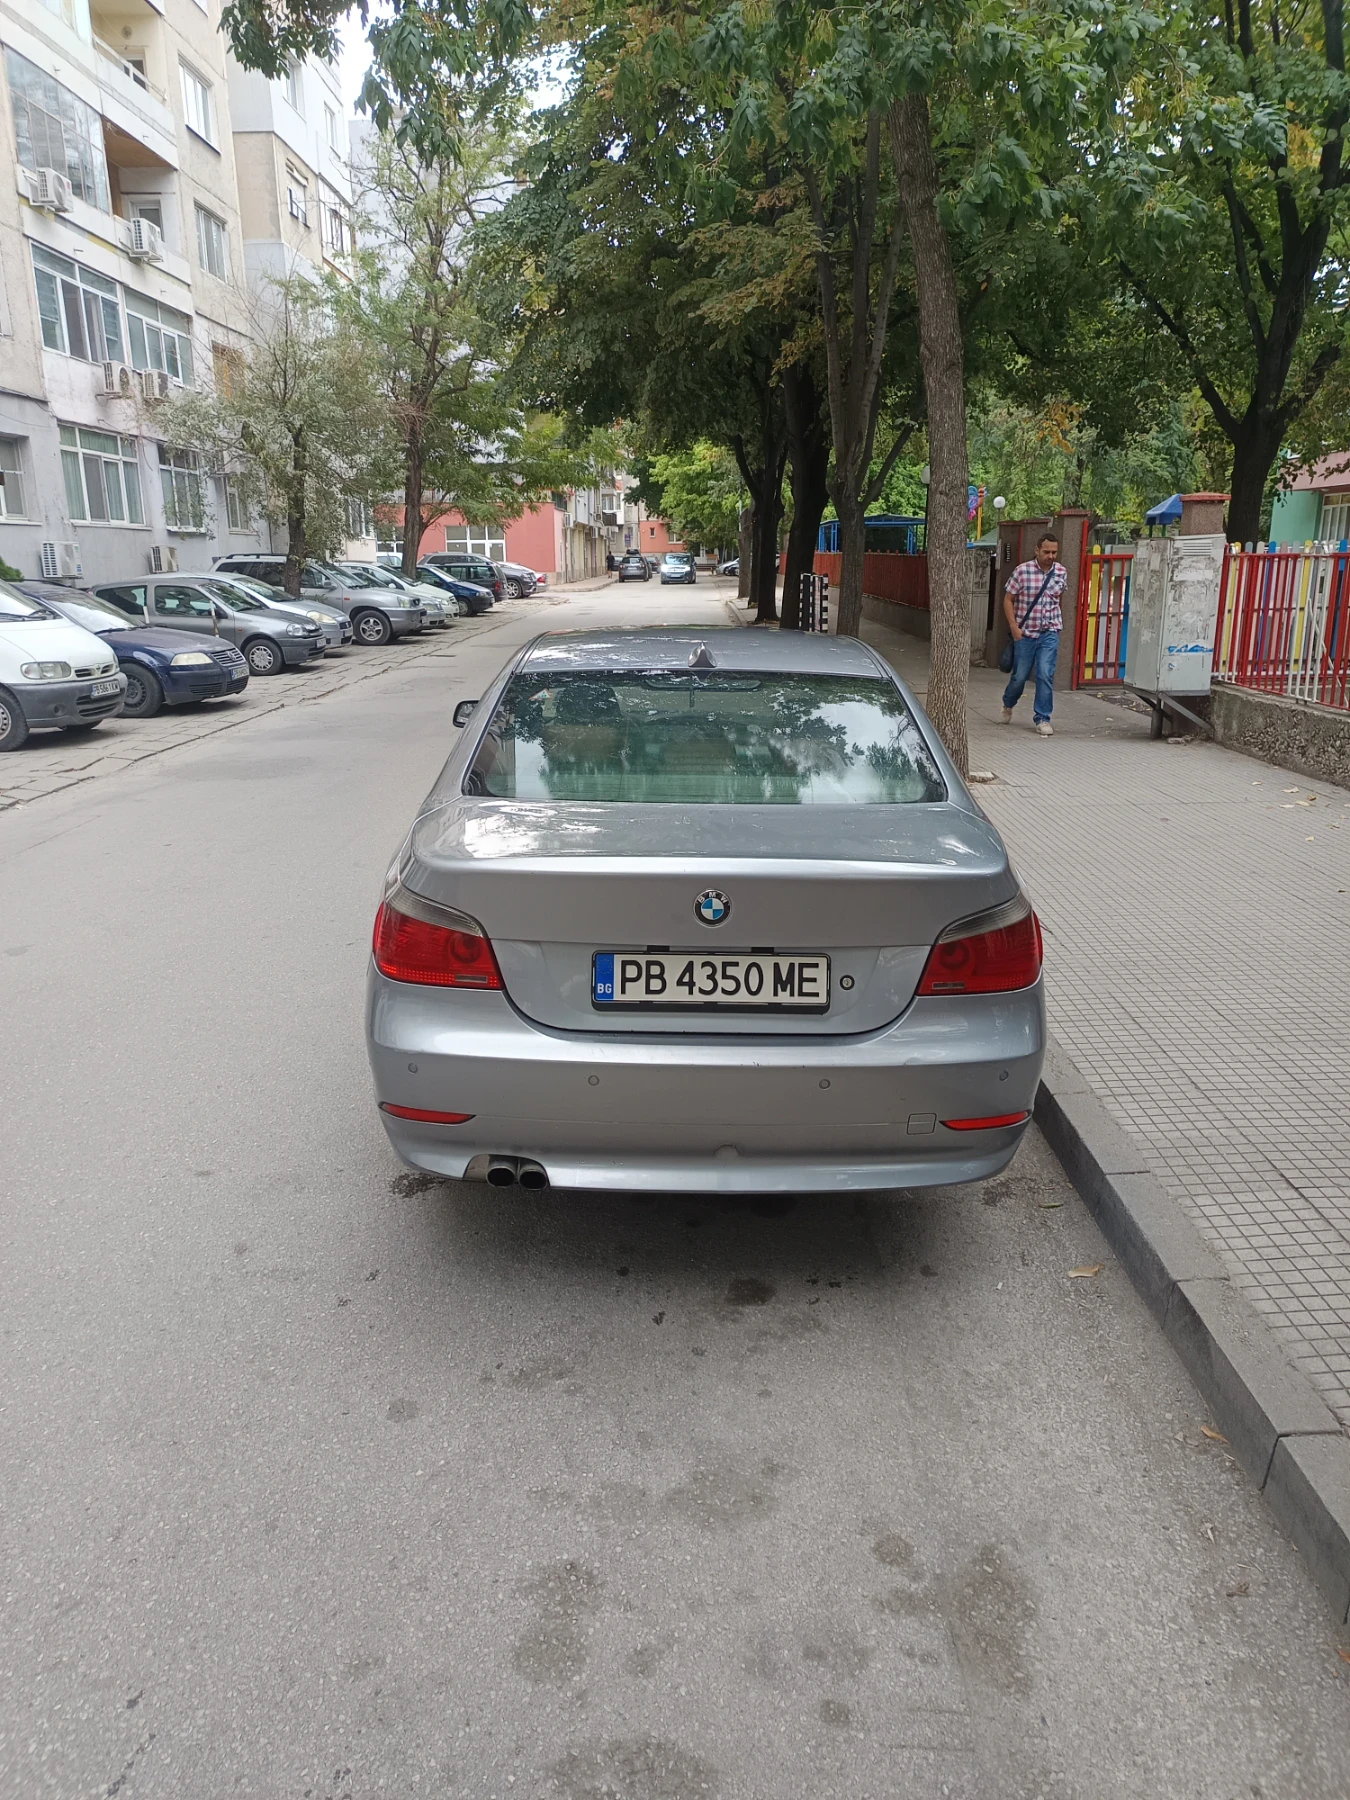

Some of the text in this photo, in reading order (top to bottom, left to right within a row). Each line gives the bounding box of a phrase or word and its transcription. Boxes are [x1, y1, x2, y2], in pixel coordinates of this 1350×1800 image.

[697, 891, 728, 904] BMW
[621, 960, 820, 997] PB 4350 ME
[597, 983, 613, 994] BG
